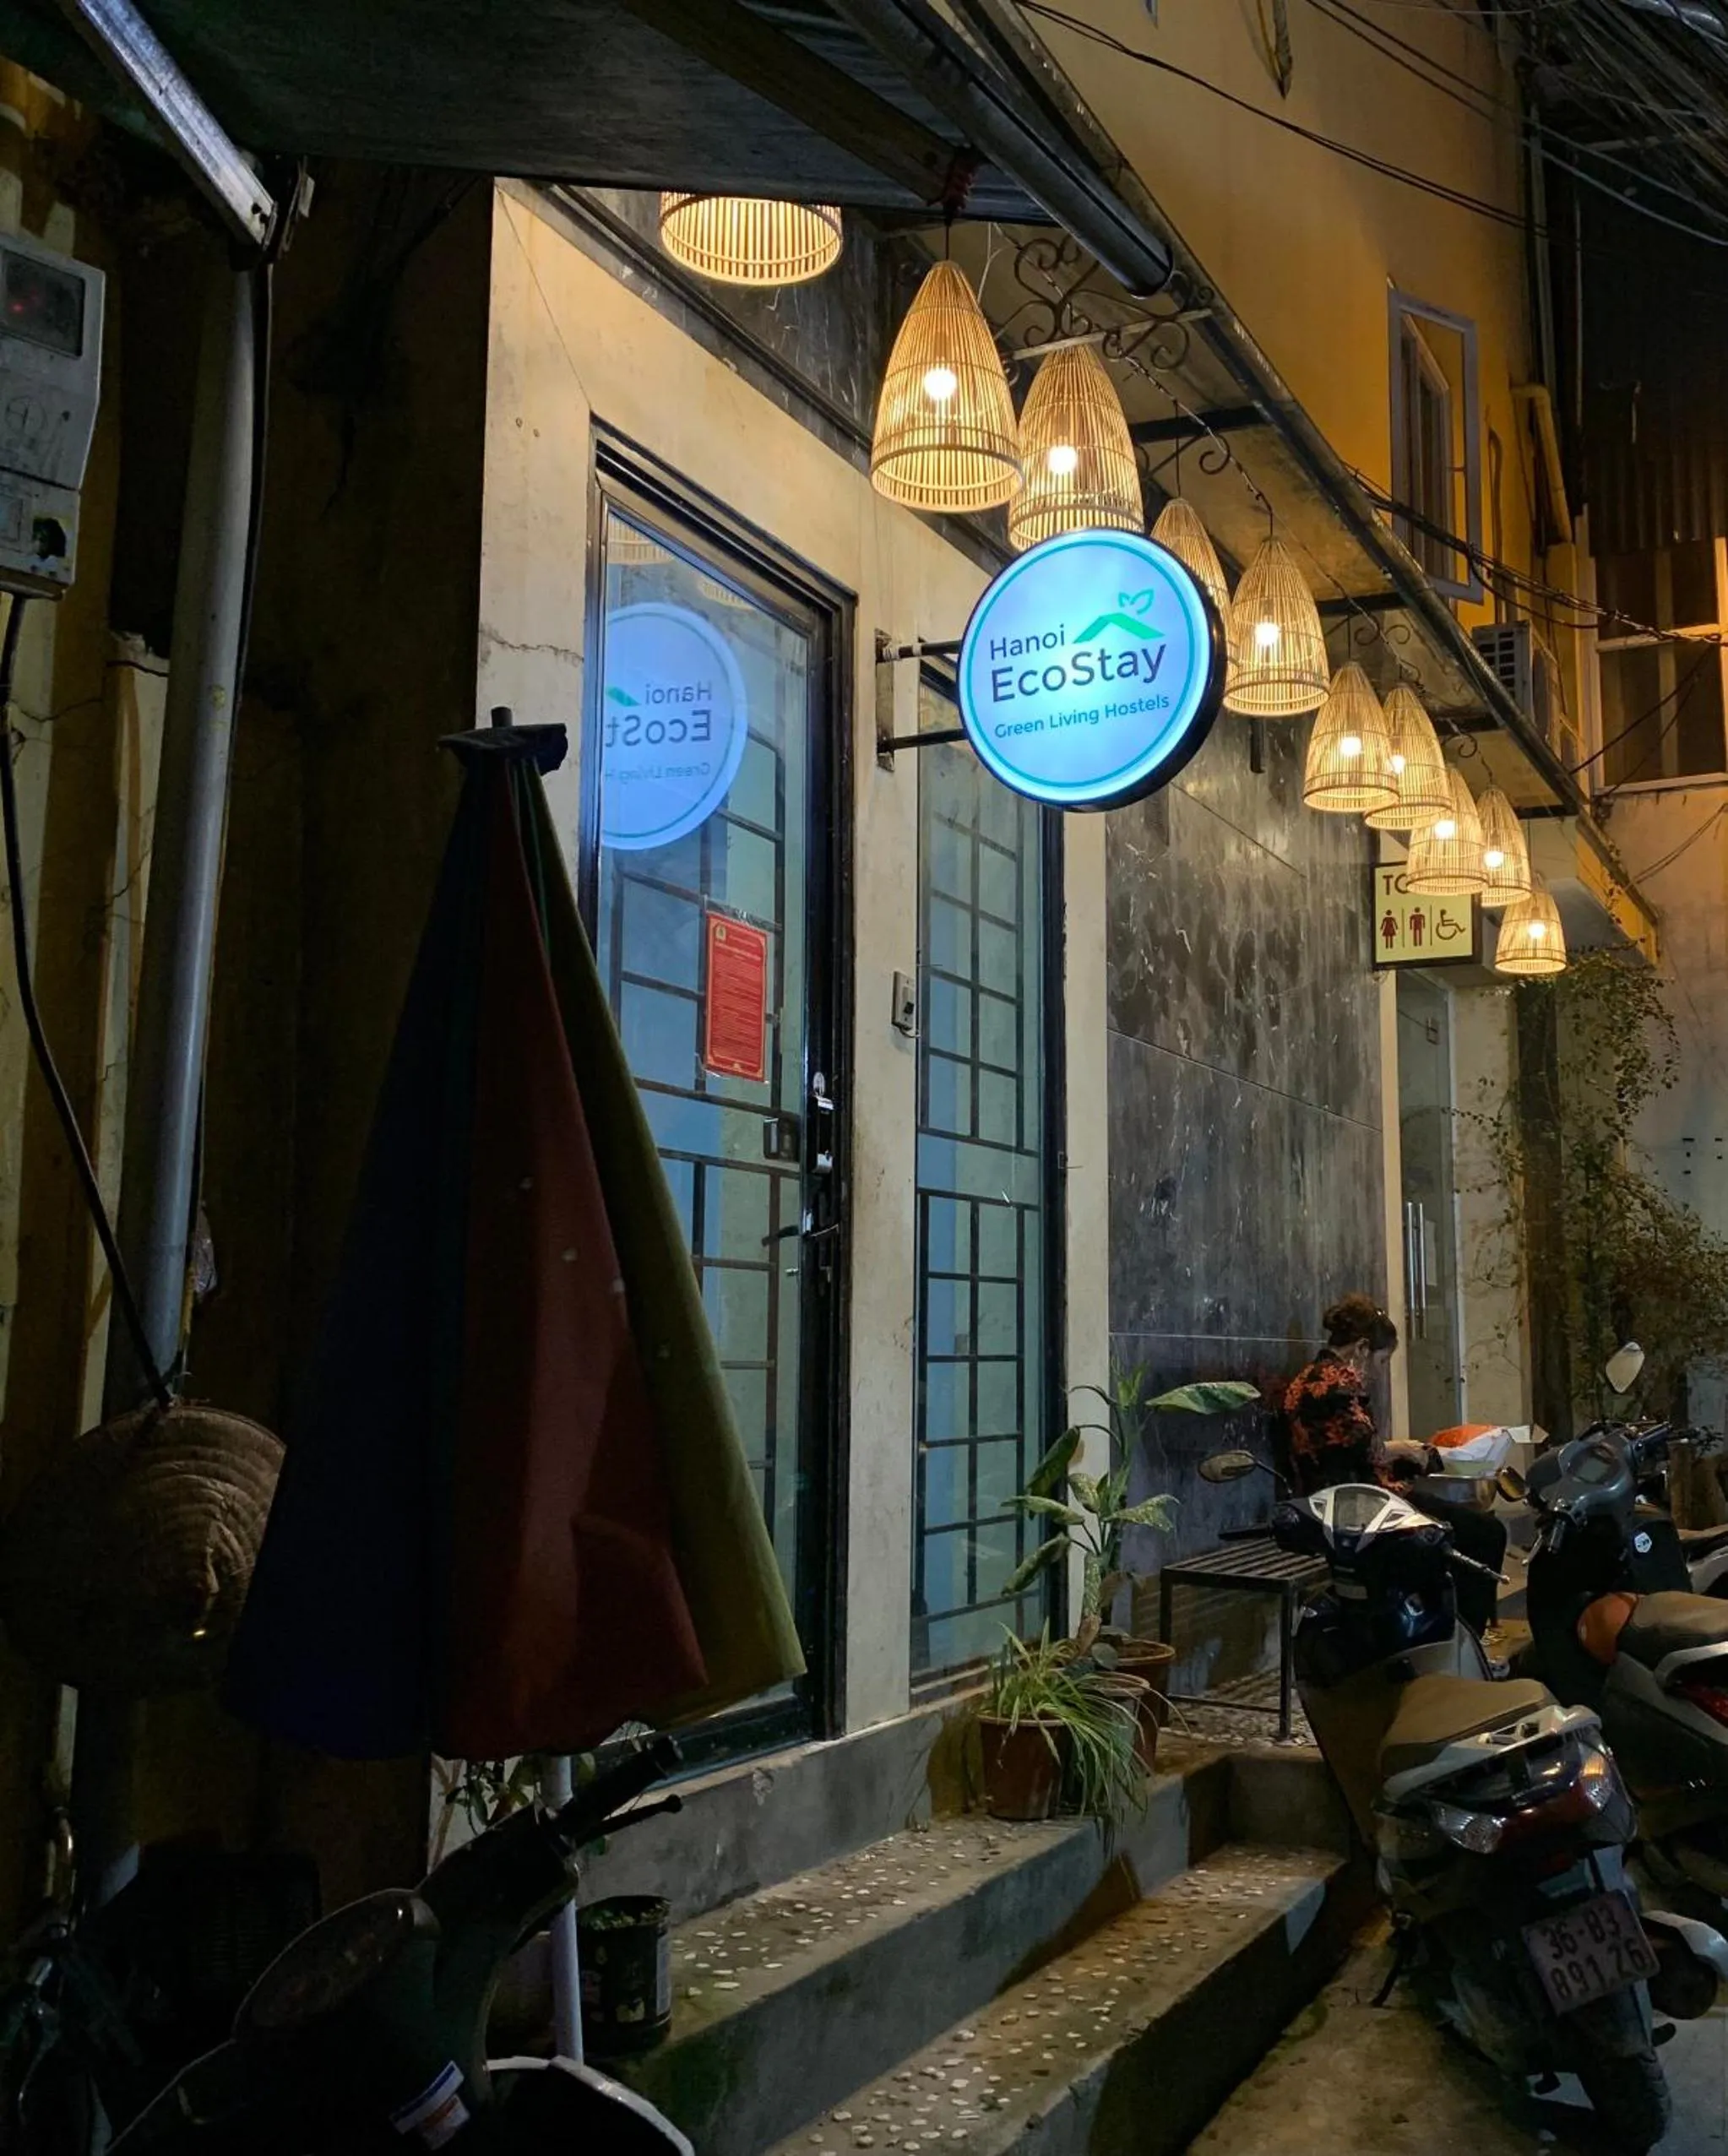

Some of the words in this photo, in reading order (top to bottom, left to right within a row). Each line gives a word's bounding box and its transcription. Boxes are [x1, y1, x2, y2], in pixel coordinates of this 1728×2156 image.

[989, 623, 1066, 660] Hanoi
[991, 644, 1167, 703] EcoStay
[994, 719, 1045, 739] Green
[1049, 708, 1100, 729] Living
[1104, 693, 1171, 719] Hostels
